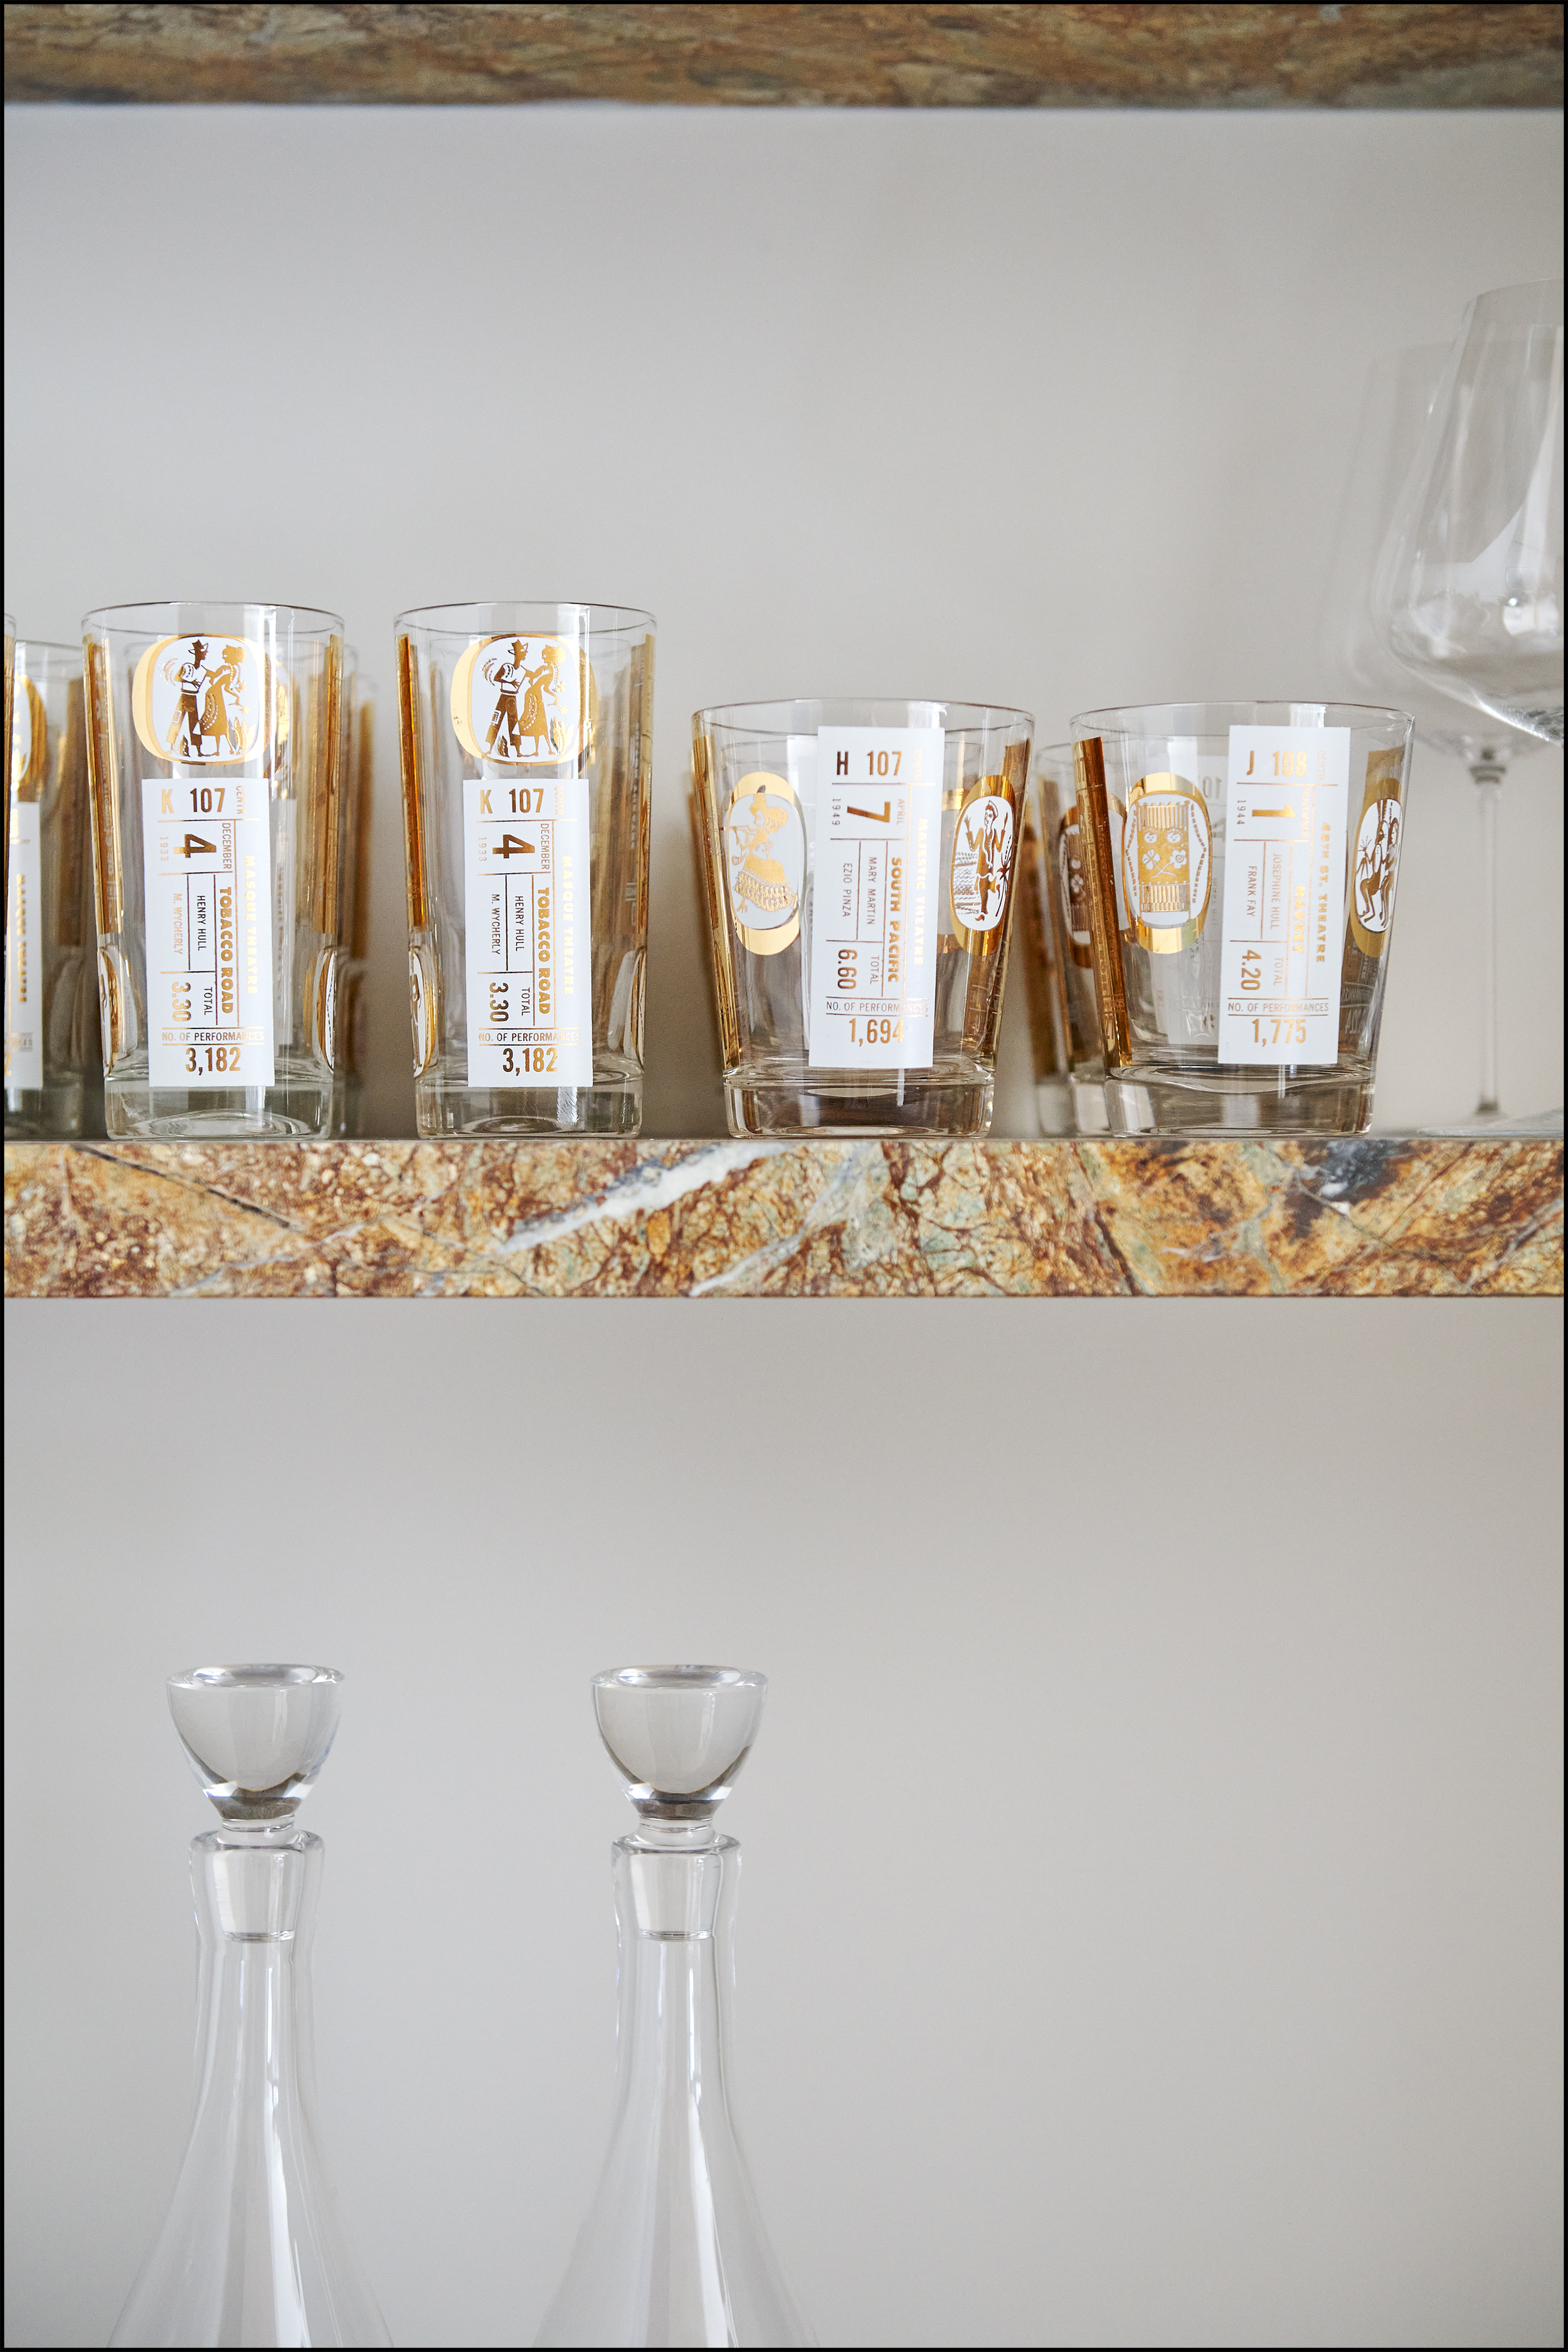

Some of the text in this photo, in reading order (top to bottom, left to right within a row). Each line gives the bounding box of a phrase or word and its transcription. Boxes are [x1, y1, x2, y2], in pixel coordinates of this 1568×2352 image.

[837, 750, 902, 776] H 107
[1246, 750, 1308, 776] J 108
[1317, 750, 1326, 780] CENTR
[161, 788, 225, 813] K 107
[236, 785, 246, 815] CENTR
[480, 788, 544, 814] K 107
[554, 786, 564, 815] CENTR
[832, 798, 841, 825] 1949
[847, 801, 891, 823] 7
[896, 798, 906, 825] APRIL
[1237, 800, 1246, 825] 1944
[1252, 803, 1296, 817] 1
[1300, 788, 1310, 838] NOVEMBER
[160, 837, 169, 861] 1933
[174, 834, 216, 858] 4
[222, 823, 233, 869] DECEMBER
[478, 837, 487, 861] 1933
[492, 834, 535, 859] 4
[540, 824, 550, 870] DECEMBER
[842, 863, 852, 917] EZIO PINZA
[867, 857, 877, 924] MARY MARTIN
[1319, 866, 1329, 886] ST.
[914, 818, 928, 965] MAJESTIC THEATRE
[1247, 866, 1258, 917] FRANK FAY
[1271, 853, 1282, 930] JOSEPHINE HULL
[173, 893, 183, 955] M. WYCHERLY
[197, 896, 206, 951] HENRY HULL
[245, 856, 258, 993] MASQUE THEATRE
[492, 894, 501, 955] M. WYCHERLY
[515, 896, 524, 951] HENRY HULL
[562, 856, 574, 994] MASQUE THEATRE
[888, 857, 903, 982] SOUTH PACIFIC
[1293, 886, 1306, 954] HARVEY
[1316, 894, 1327, 962] THEATRE
[220, 887, 233, 1013] TOBACCO ROAD
[538, 887, 551, 1014] TOBACCO ROAD
[837, 948, 857, 989] 6.60
[870, 955, 879, 985] TOTAL
[1241, 950, 1262, 990] 4.20
[1273, 957, 1284, 986] TOTAL
[172, 982, 191, 1021] 3.30
[204, 987, 213, 1015] TOTAL
[489, 983, 509, 1022] 3.30
[521, 987, 530, 1016] TOTAL
[827, 1002, 928, 1012] NO. OF PERFORMANCES
[1228, 1003, 1329, 1012] NO. OF PERFORMANCES
[162, 1032, 265, 1041] NO. OF PERFORMANCES
[479, 1032, 580, 1041] NO. OF PERFORMANCES
[849, 1018, 905, 1047] 1,694
[1252, 1018, 1306, 1047] 1,775
[186, 1047, 241, 1076] 3,182
[502, 1047, 558, 1076] 3,182
